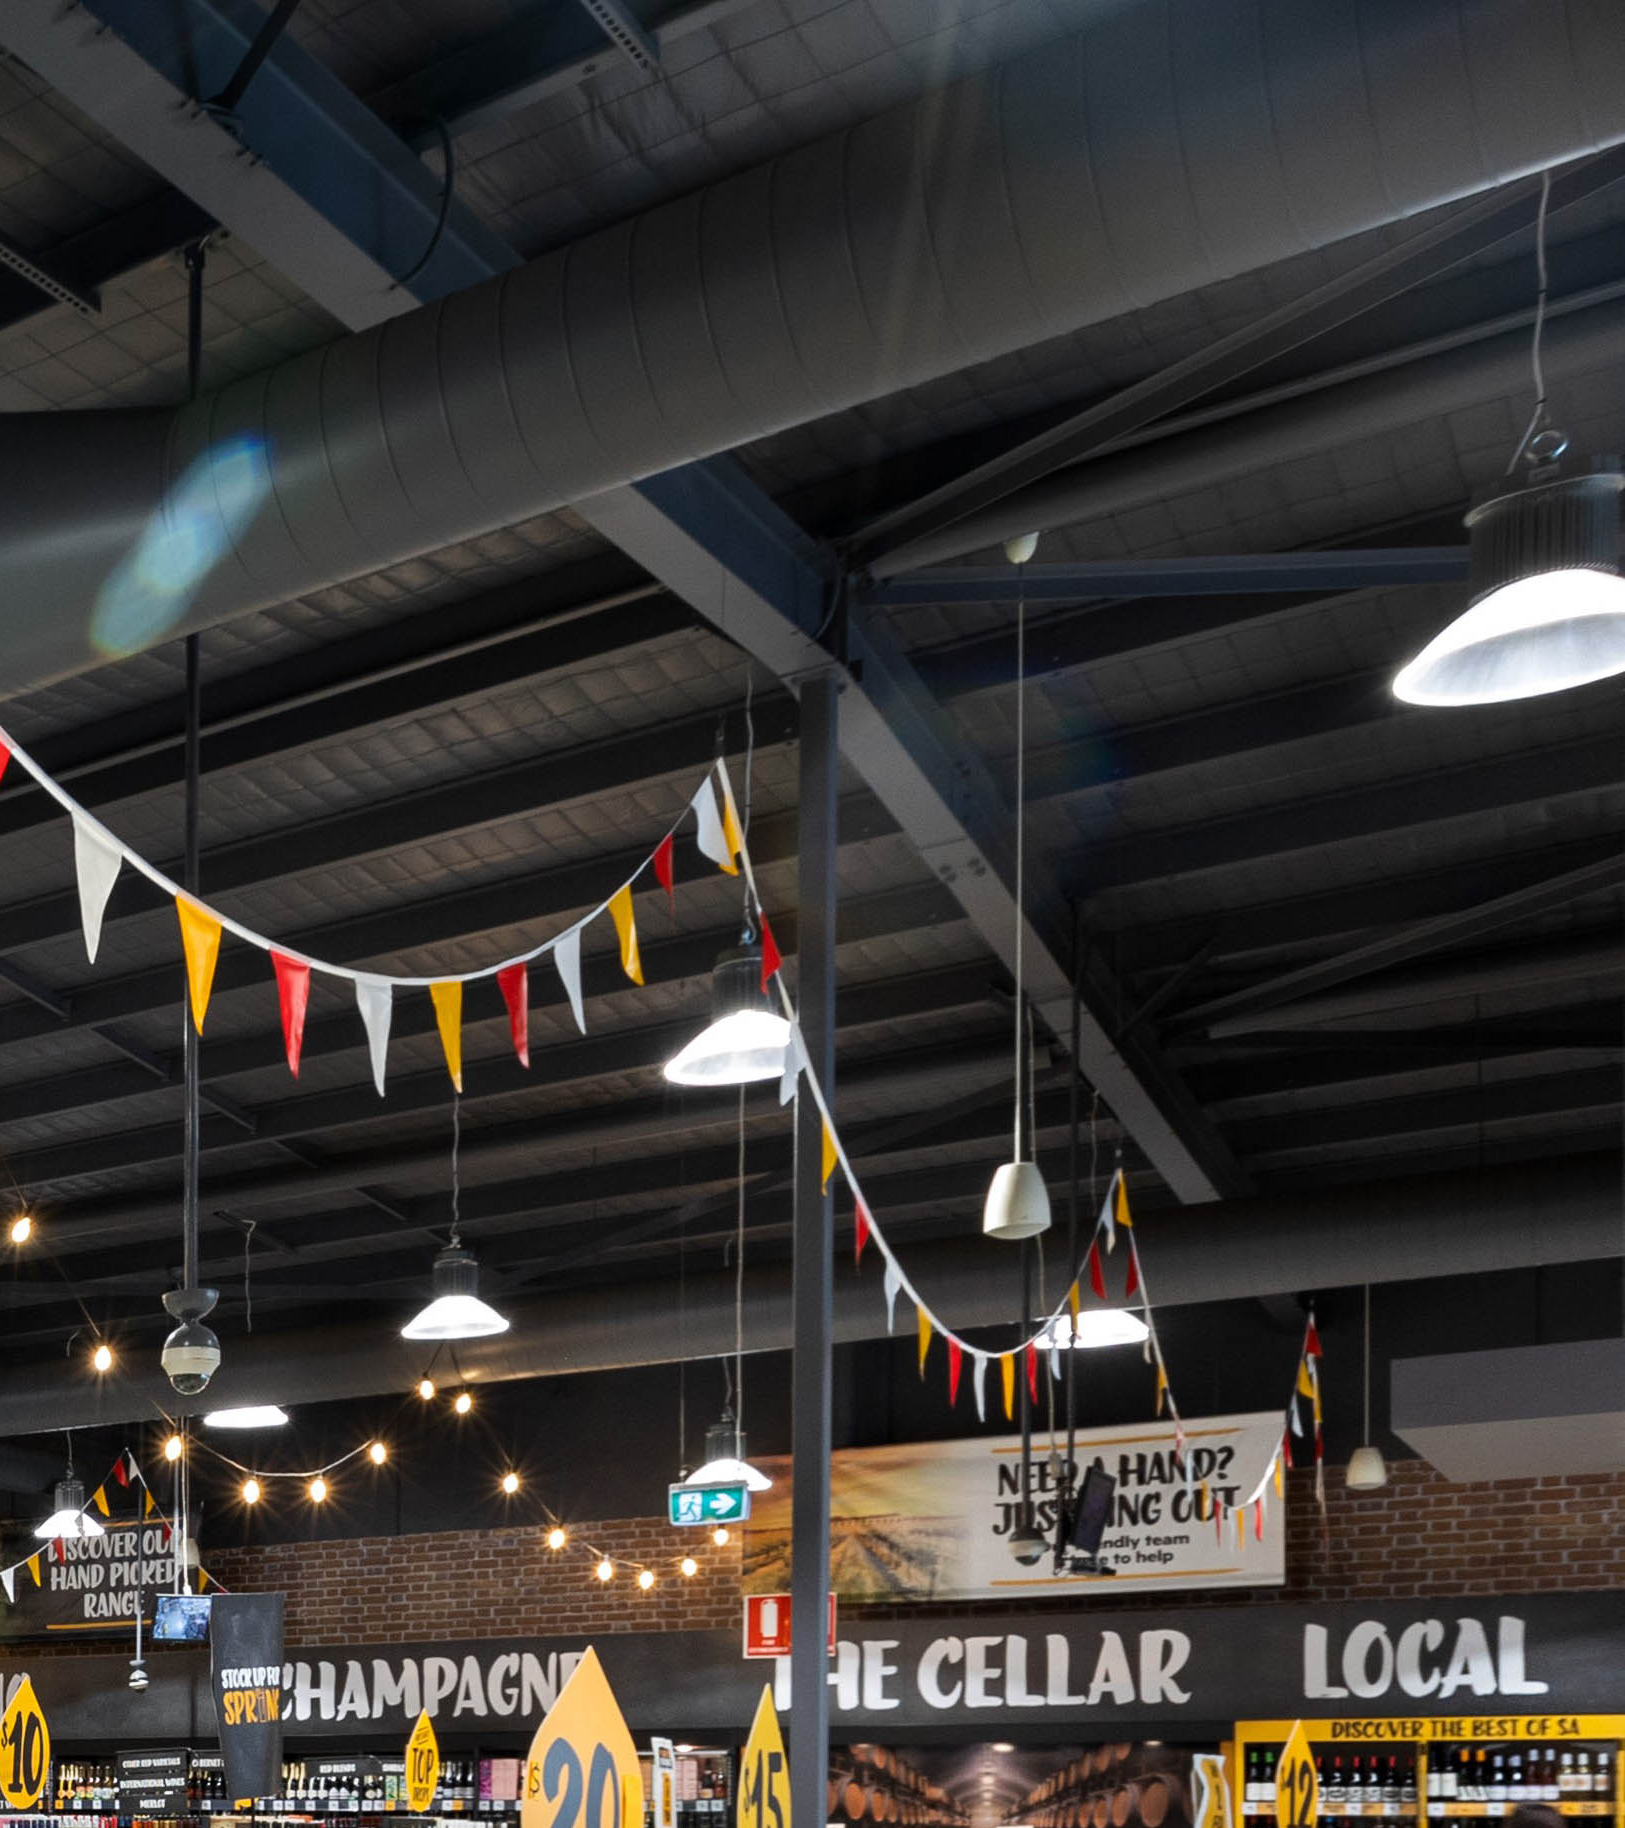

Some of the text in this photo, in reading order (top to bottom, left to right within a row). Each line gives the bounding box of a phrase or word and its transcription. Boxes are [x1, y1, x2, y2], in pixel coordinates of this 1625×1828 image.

[1119, 1446, 1235, 1487] HAND?
[1146, 1534, 1189, 1545] team
[1115, 1550, 1173, 1564] to help
[51, 1560, 182, 1591] HAND PICKED
[84, 1591, 144, 1618] RANGE
[917, 1628, 1192, 1709] CELLAR
[1303, 1617, 1549, 1699] LOCAL
[1332, 1719, 1580, 1738] DISCOVER THE BEST OF SA
[2, 1711, 43, 1792] $10
[413, 1747, 432, 1782] TOP
[140, 1799, 165, 1808] MERLOT
